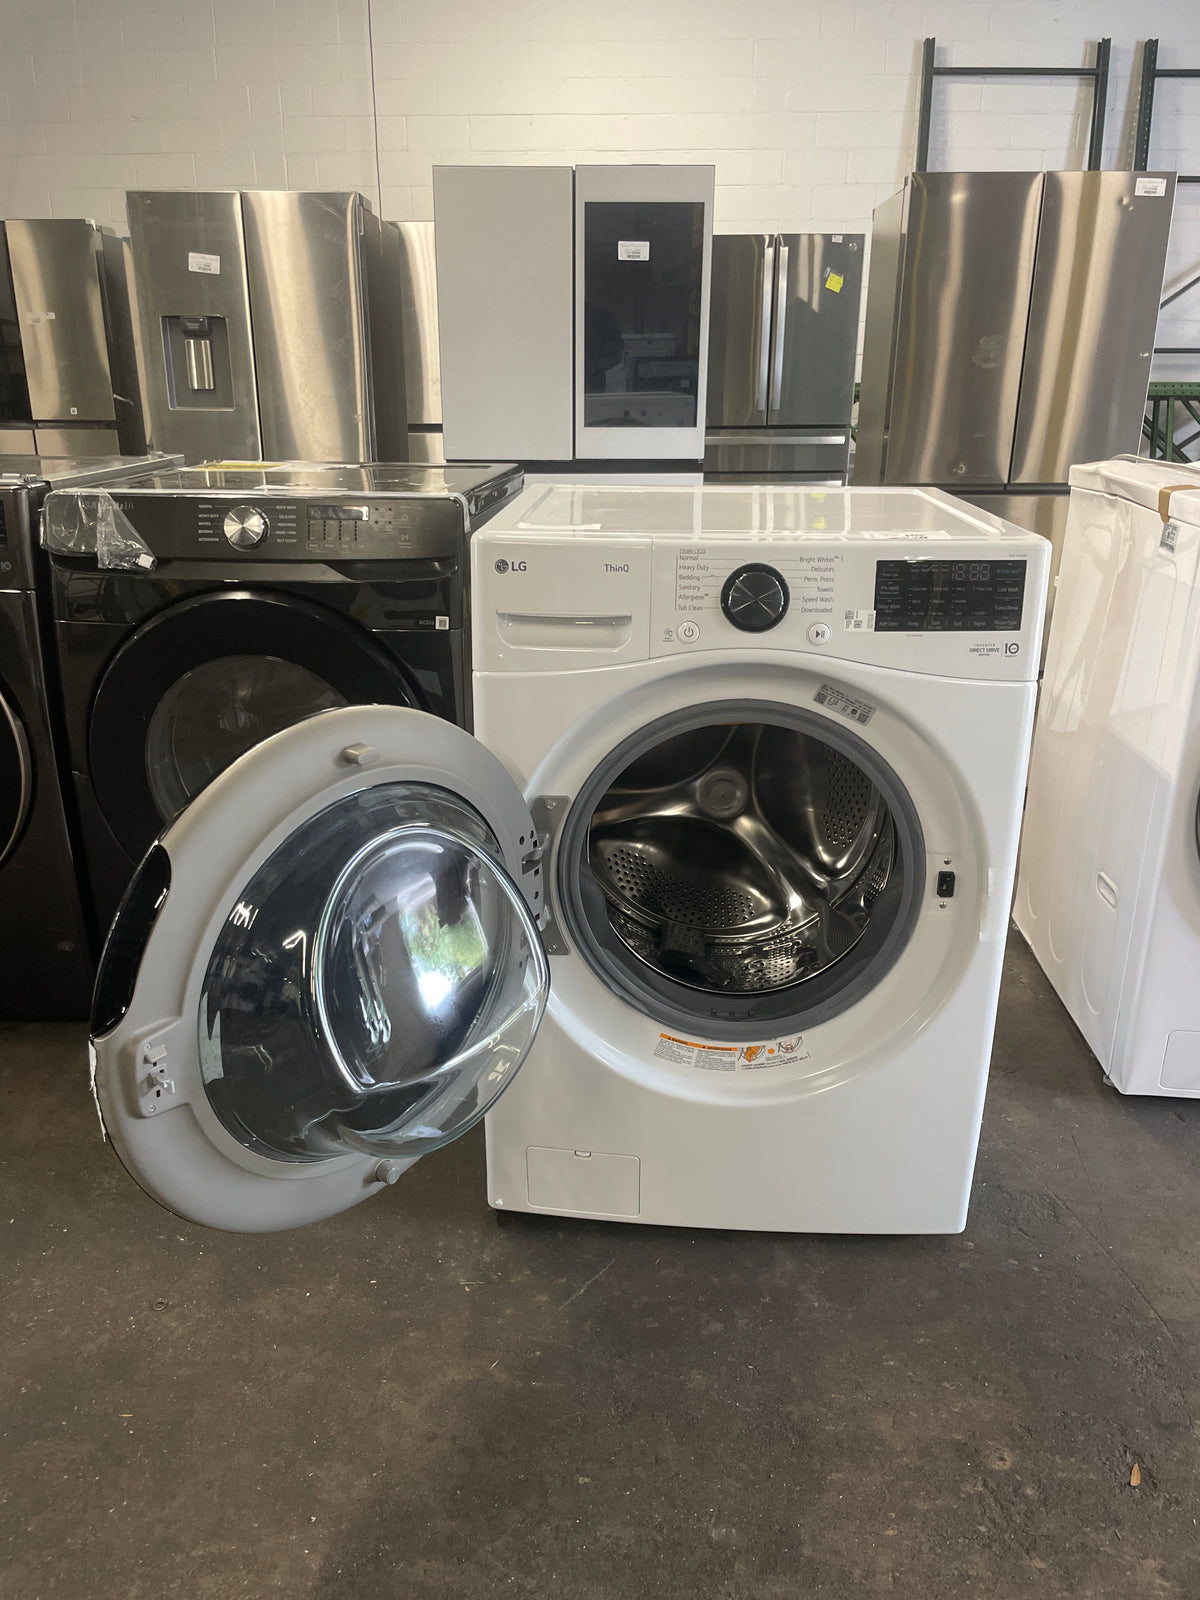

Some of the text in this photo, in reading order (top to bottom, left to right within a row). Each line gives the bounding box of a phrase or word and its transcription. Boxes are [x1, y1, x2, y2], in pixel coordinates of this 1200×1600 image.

[511, 561, 527, 572] LG
[604, 563, 629, 573] ThinQ
[1005, 643, 1020, 654] 10
